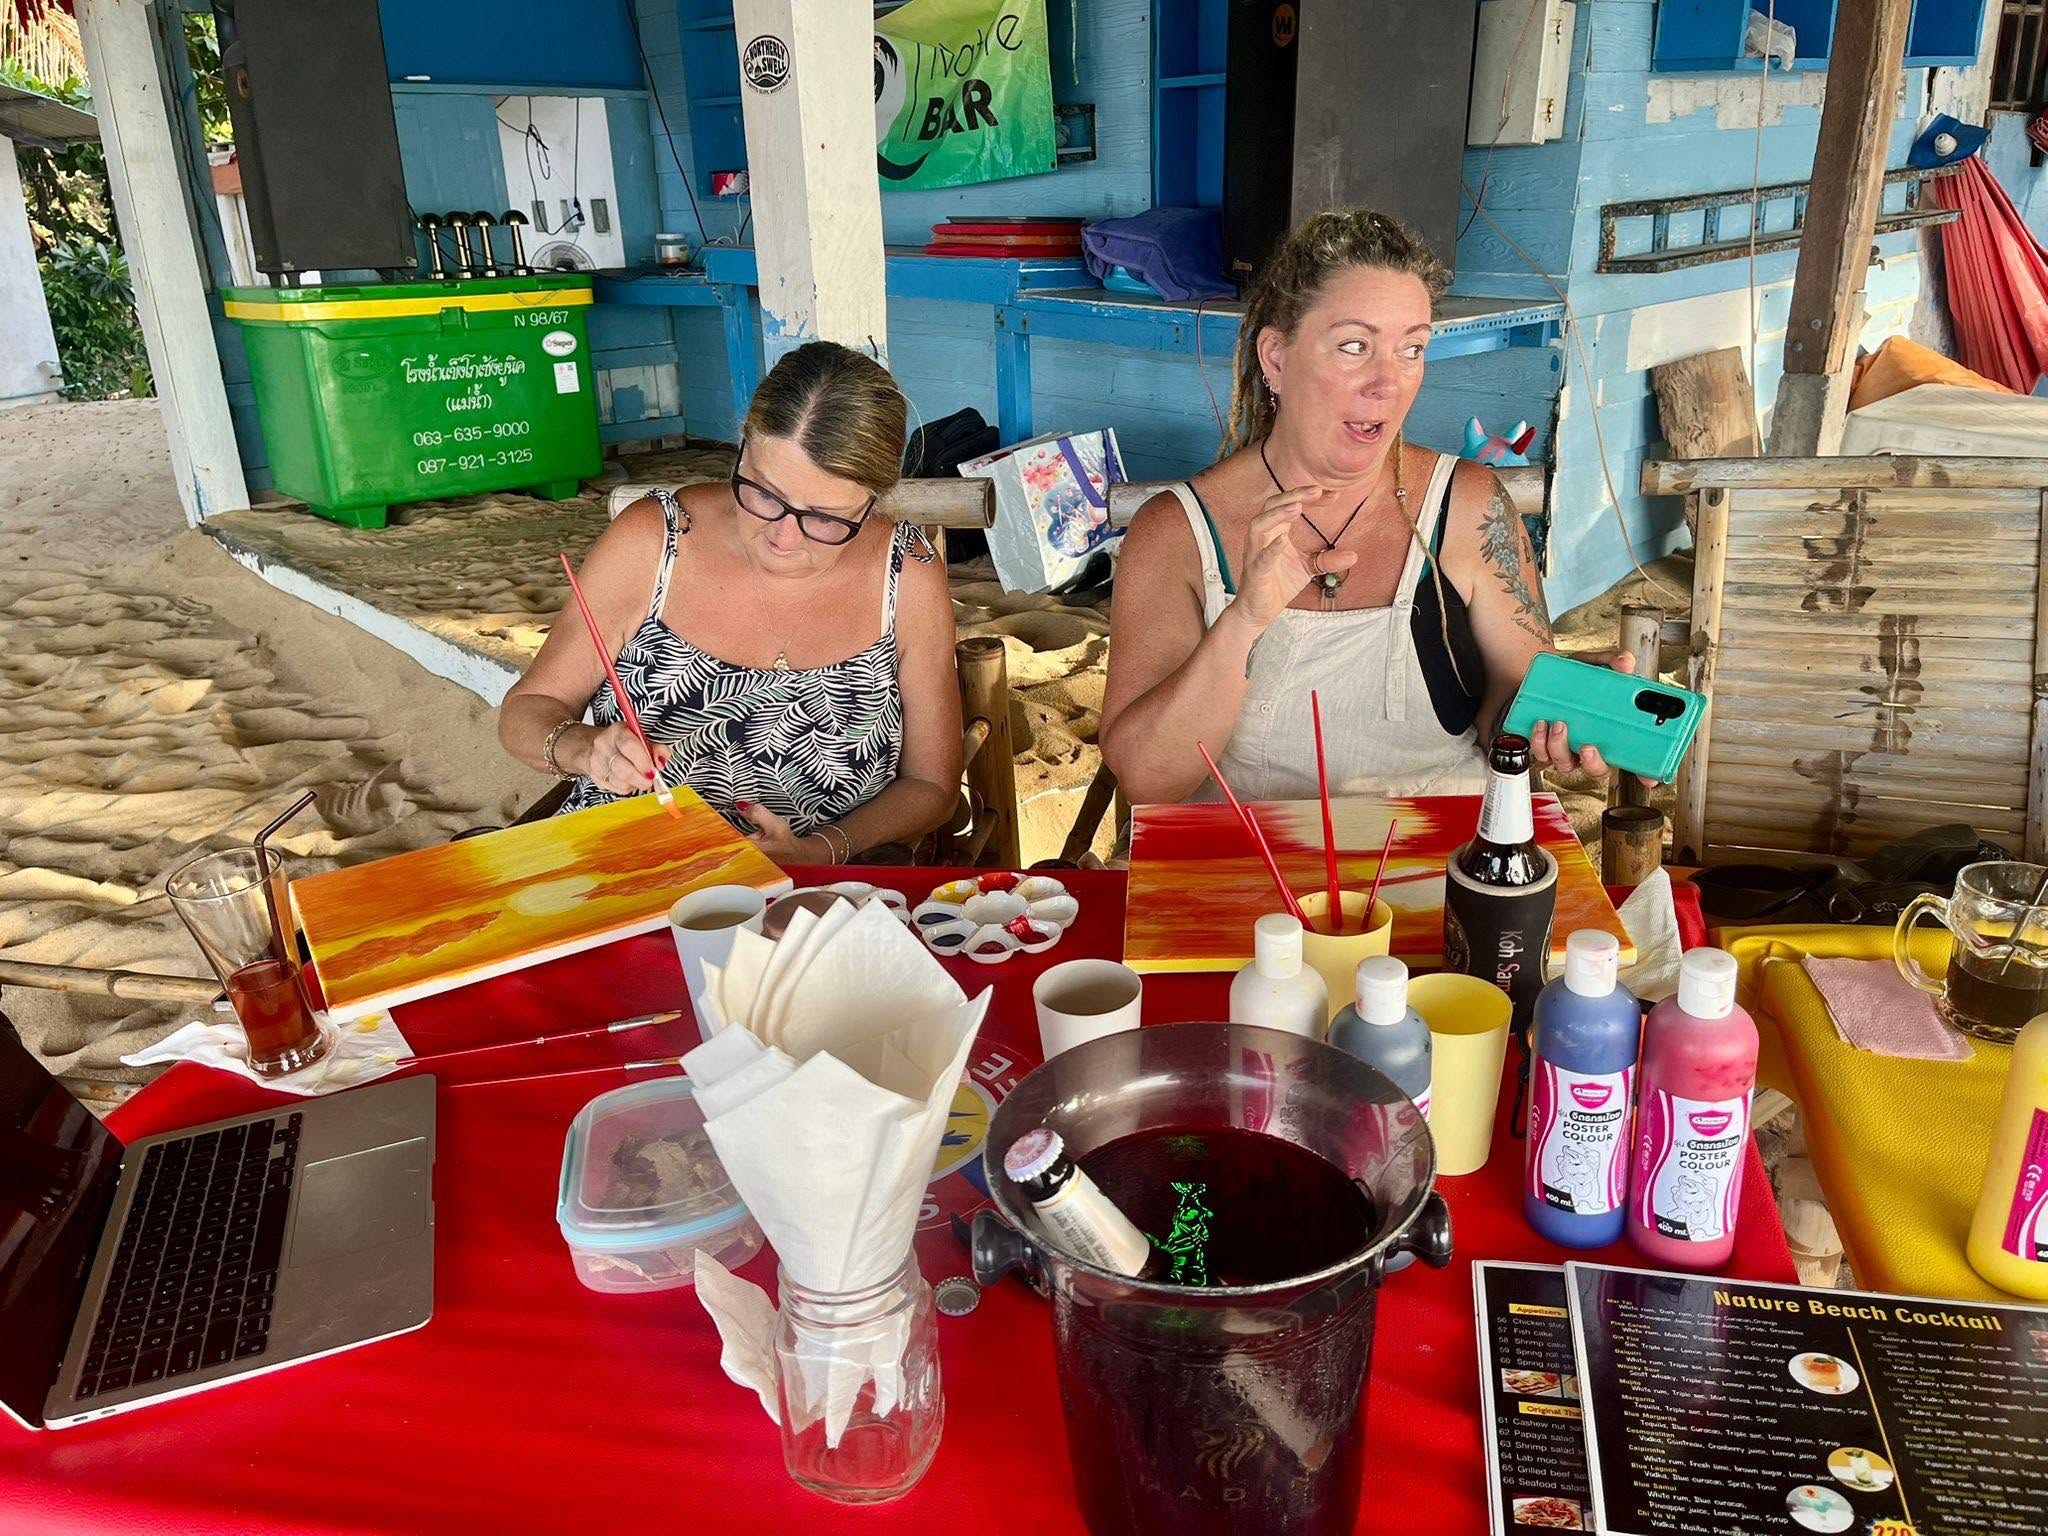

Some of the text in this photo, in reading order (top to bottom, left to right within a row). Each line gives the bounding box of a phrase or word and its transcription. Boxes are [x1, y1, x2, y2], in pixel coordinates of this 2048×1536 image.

[749, 40, 785, 61] NORTHERLY
[762, 57, 787, 75] SWELL
[917, 79, 998, 140] BAR
[514, 311, 568, 327] N 98/67
[414, 421, 529, 446] 063-635-9000
[418, 448, 532, 474] 087-921-3125
[1496, 930, 1524, 993] Koh Sam
[1563, 1120, 1609, 1133] POSTER
[1562, 1130, 1613, 1142] COLOUR
[1680, 1150, 1727, 1161] POSTER
[1679, 1159, 1731, 1170] COLOUR
[1545, 1192, 1559, 1203] 400
[1657, 1222, 1673, 1233] 400
[1517, 1306, 1562, 1316] Appetizers
[1714, 1291, 2003, 1331] Nature Beach Cocktail
[1513, 1318, 1545, 1327] Chicken
[1515, 1338, 1544, 1347] Shrimp
[1516, 1348, 1542, 1357] Spring
[1517, 1358, 1544, 1368] Spring
[1526, 1406, 1561, 1415] Original
[1513, 1418, 1548, 1428] Cashew
[1499, 1428, 1510, 1436] 62
[1514, 1430, 1547, 1440] Papaya
[1500, 1440, 1511, 1448] 63
[1515, 1441, 1547, 1452] Shrimp
[1550, 1446, 1574, 1454] salad
[1516, 1453, 1533, 1461] Lab
[1518, 1465, 1547, 1475] Grilled
[1550, 1469, 1570, 1478] beef
[1503, 1476, 1514, 1484] 66
[1519, 1478, 1557, 1488] Seafood
[1765, 1515, 1789, 1524] Syrup
